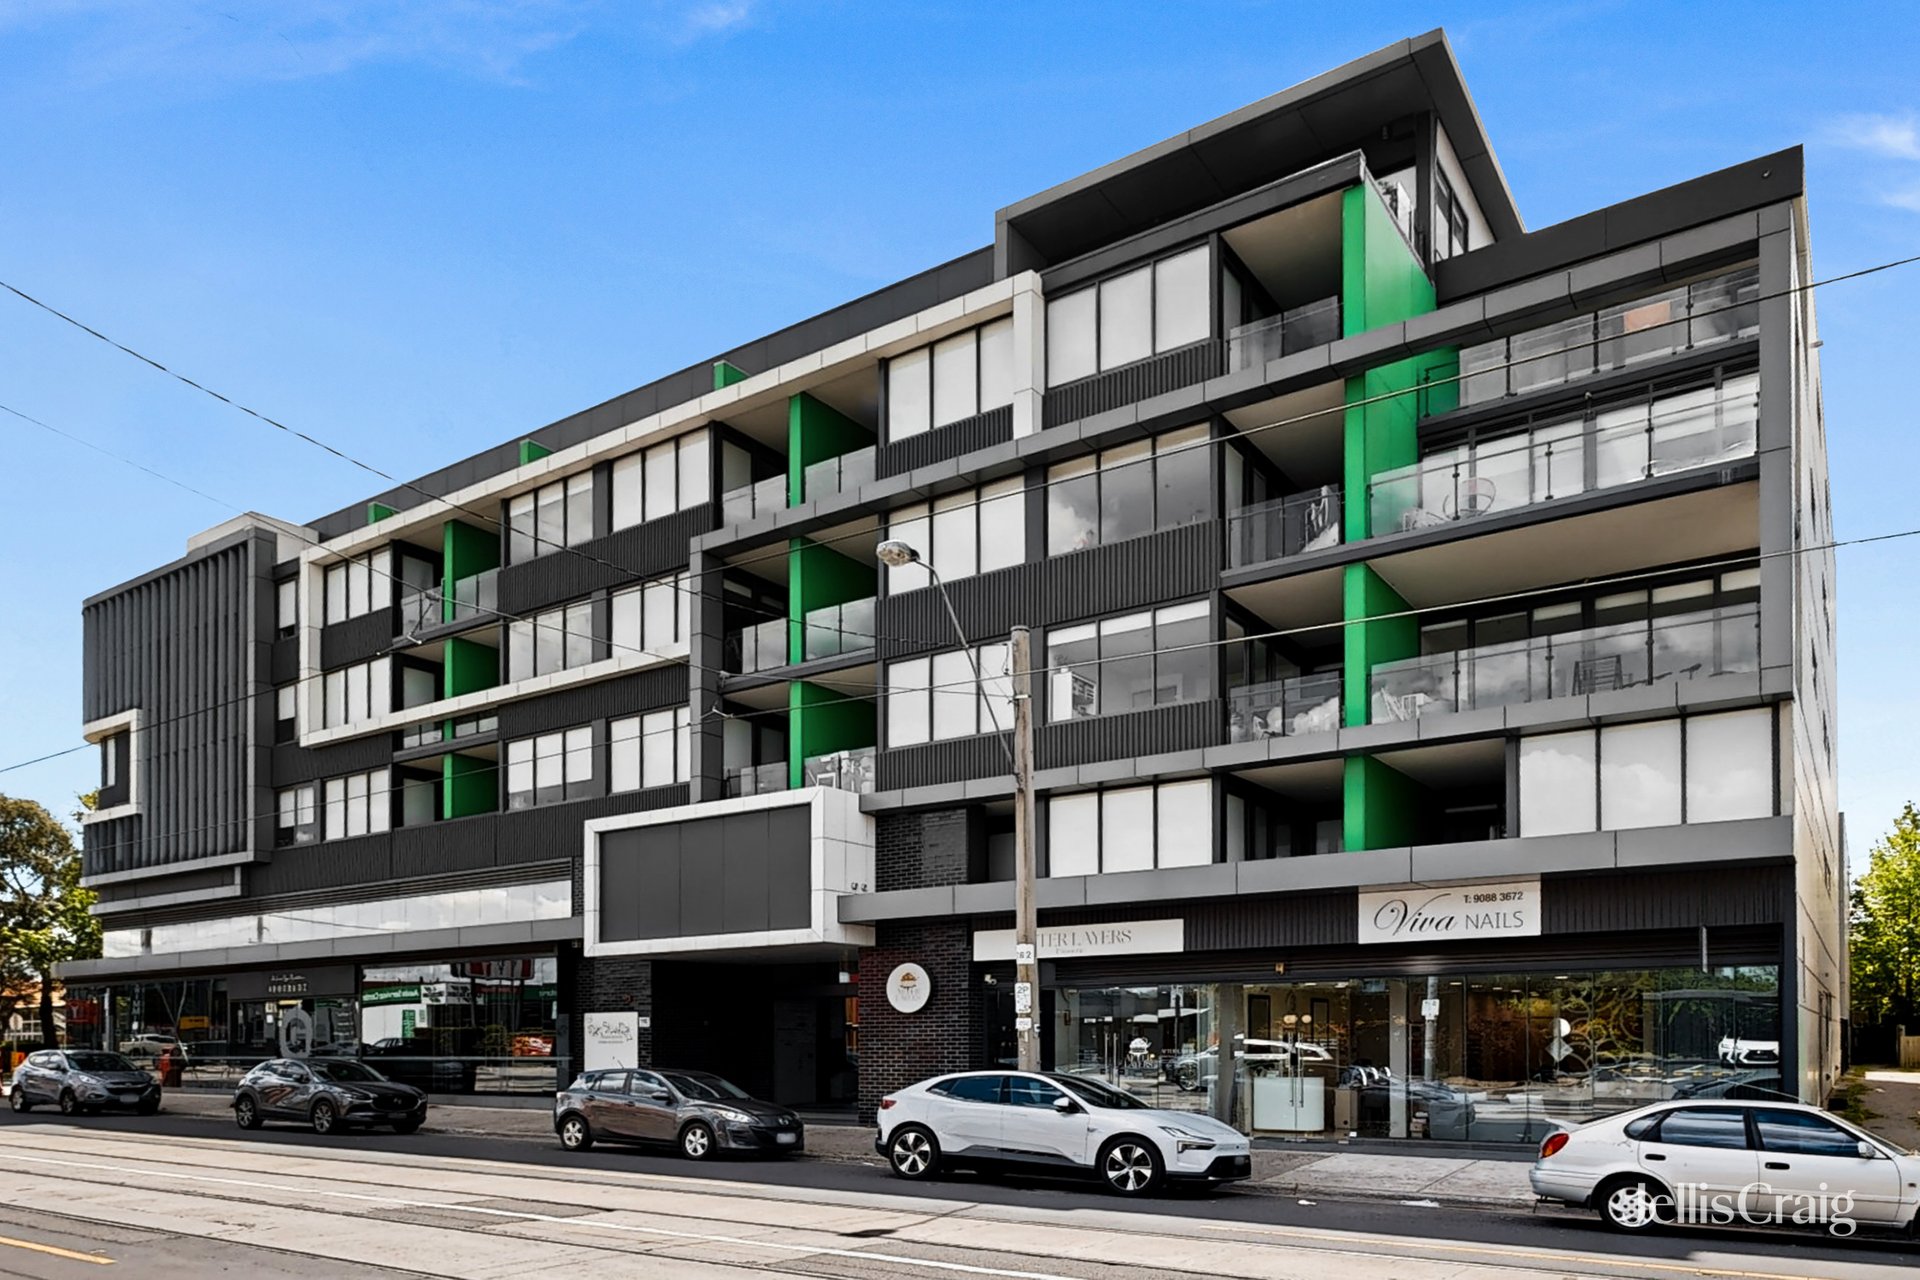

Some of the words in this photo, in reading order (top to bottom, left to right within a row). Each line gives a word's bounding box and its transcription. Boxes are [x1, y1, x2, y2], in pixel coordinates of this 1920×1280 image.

[1464, 895, 1471, 903] T:
[1474, 894, 1497, 903] 9088
[1500, 892, 1523, 901] 3672
[1374, 893, 1458, 936] Viva
[1465, 911, 1524, 930] NAILS
[1036, 933, 1068, 948] TER
